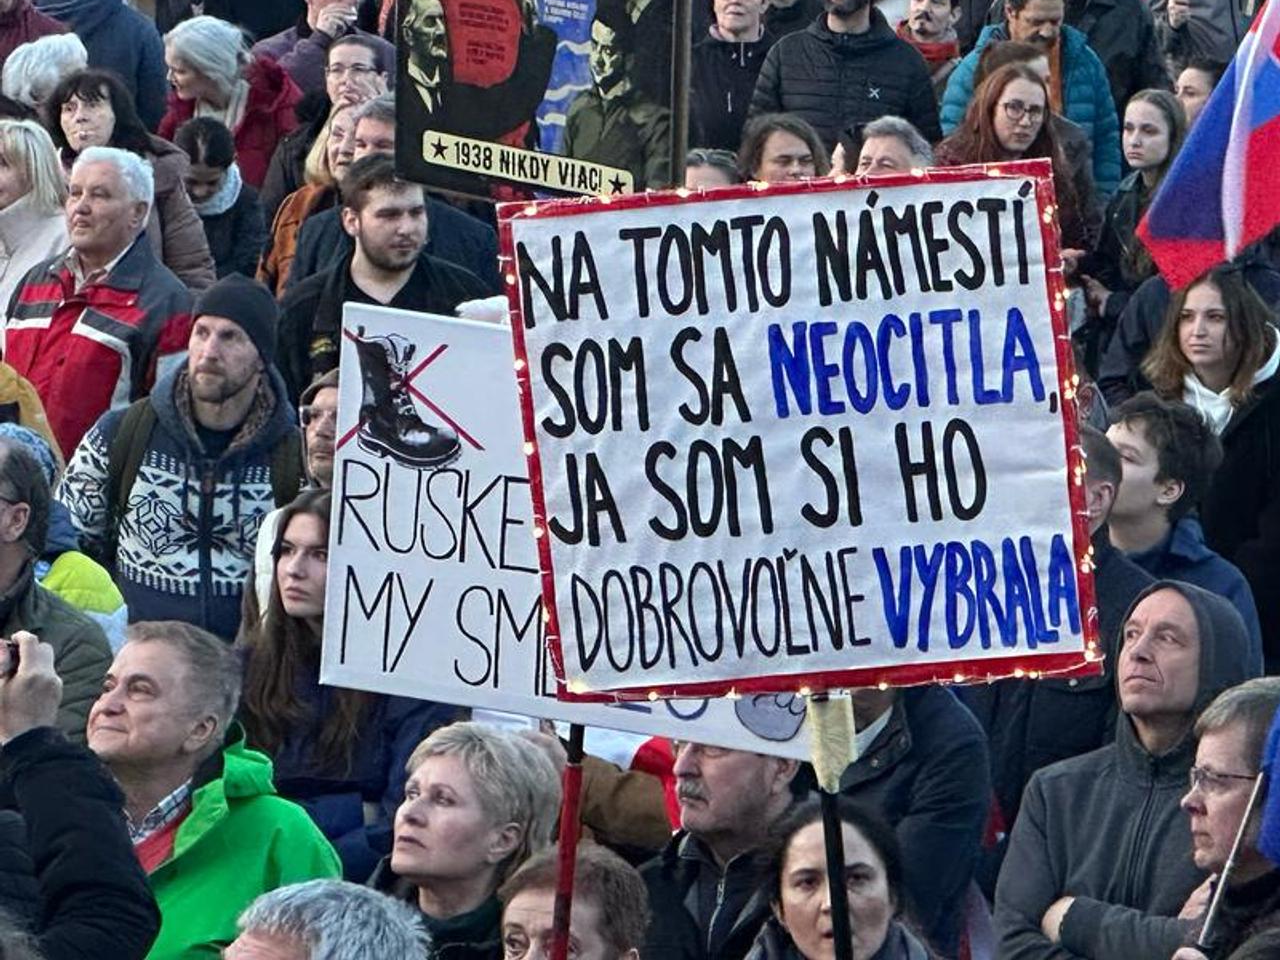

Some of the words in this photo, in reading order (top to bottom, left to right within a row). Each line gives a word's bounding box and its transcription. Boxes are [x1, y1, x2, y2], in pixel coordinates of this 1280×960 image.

[454, 140, 493, 171] 1938
[500, 149, 550, 182] NIKDY
[558, 162, 602, 193] VIAC!
[517, 230, 608, 329] NA
[619, 214, 792, 319] TOMTO
[813, 181, 1033, 307] NÁMESTÍ
[541, 337, 650, 438] SOM
[670, 326, 752, 425] SA
[767, 307, 1058, 419] NEOCITLA,
[548, 452, 627, 546] JA
[644, 435, 774, 538] SOM
[801, 426, 863, 528] SI
[895, 417, 988, 523] HO
[340, 565, 434, 673] MY
[571, 547, 871, 672] DOBROVOĽNE
[872, 533, 1081, 651] VYBRALA
